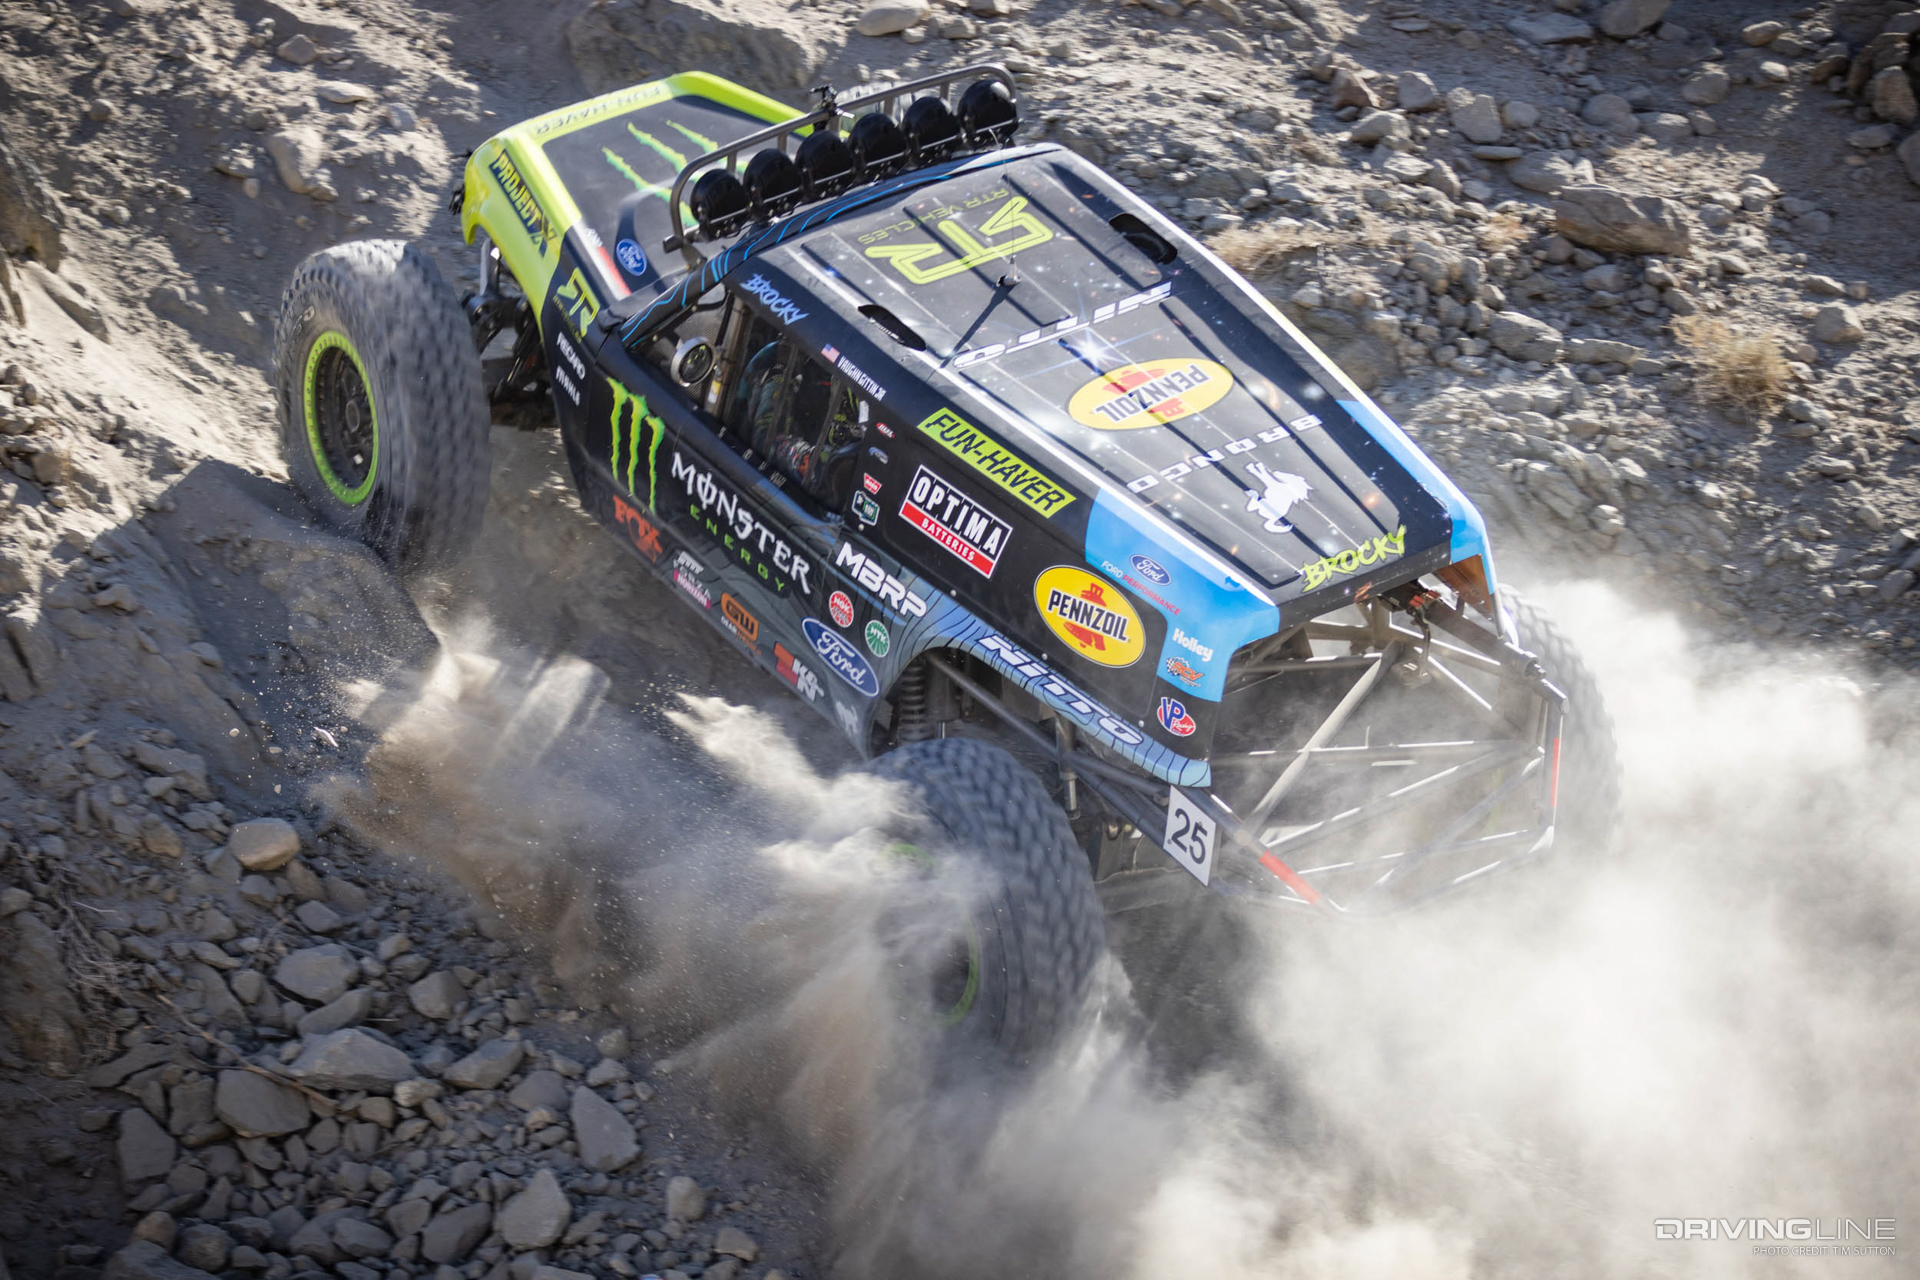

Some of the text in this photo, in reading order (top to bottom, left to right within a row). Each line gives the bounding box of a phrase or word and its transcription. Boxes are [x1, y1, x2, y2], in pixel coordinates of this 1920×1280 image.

[492, 156, 543, 236] PROJECT
[858, 189, 1009, 244] RTR VEHICLES
[739, 273, 809, 325] BROCKY
[837, 356, 887, 401] VAUGHN GITTIN JR
[1093, 363, 1213, 424] PENNZOIL
[926, 413, 1066, 511] FUN-HAVER
[1127, 414, 1323, 493] BRONCO
[613, 494, 663, 553] FOX
[672, 452, 811, 594] MONSTER
[912, 476, 1003, 555] OPTIMA
[921, 518, 976, 562] BATTERIES
[690, 503, 785, 592] ENERGY
[1135, 558, 1168, 583] Ford
[1300, 524, 1406, 593] BROCKY
[835, 542, 927, 618] MBRP
[1102, 561, 1182, 616] FORD PERFORMANCE
[1047, 590, 1129, 642] PENNZOIL
[1172, 627, 1214, 662] Holley
[816, 629, 866, 686] Ford
[1160, 697, 1187, 731] VP
[1170, 807, 1209, 865] 25
